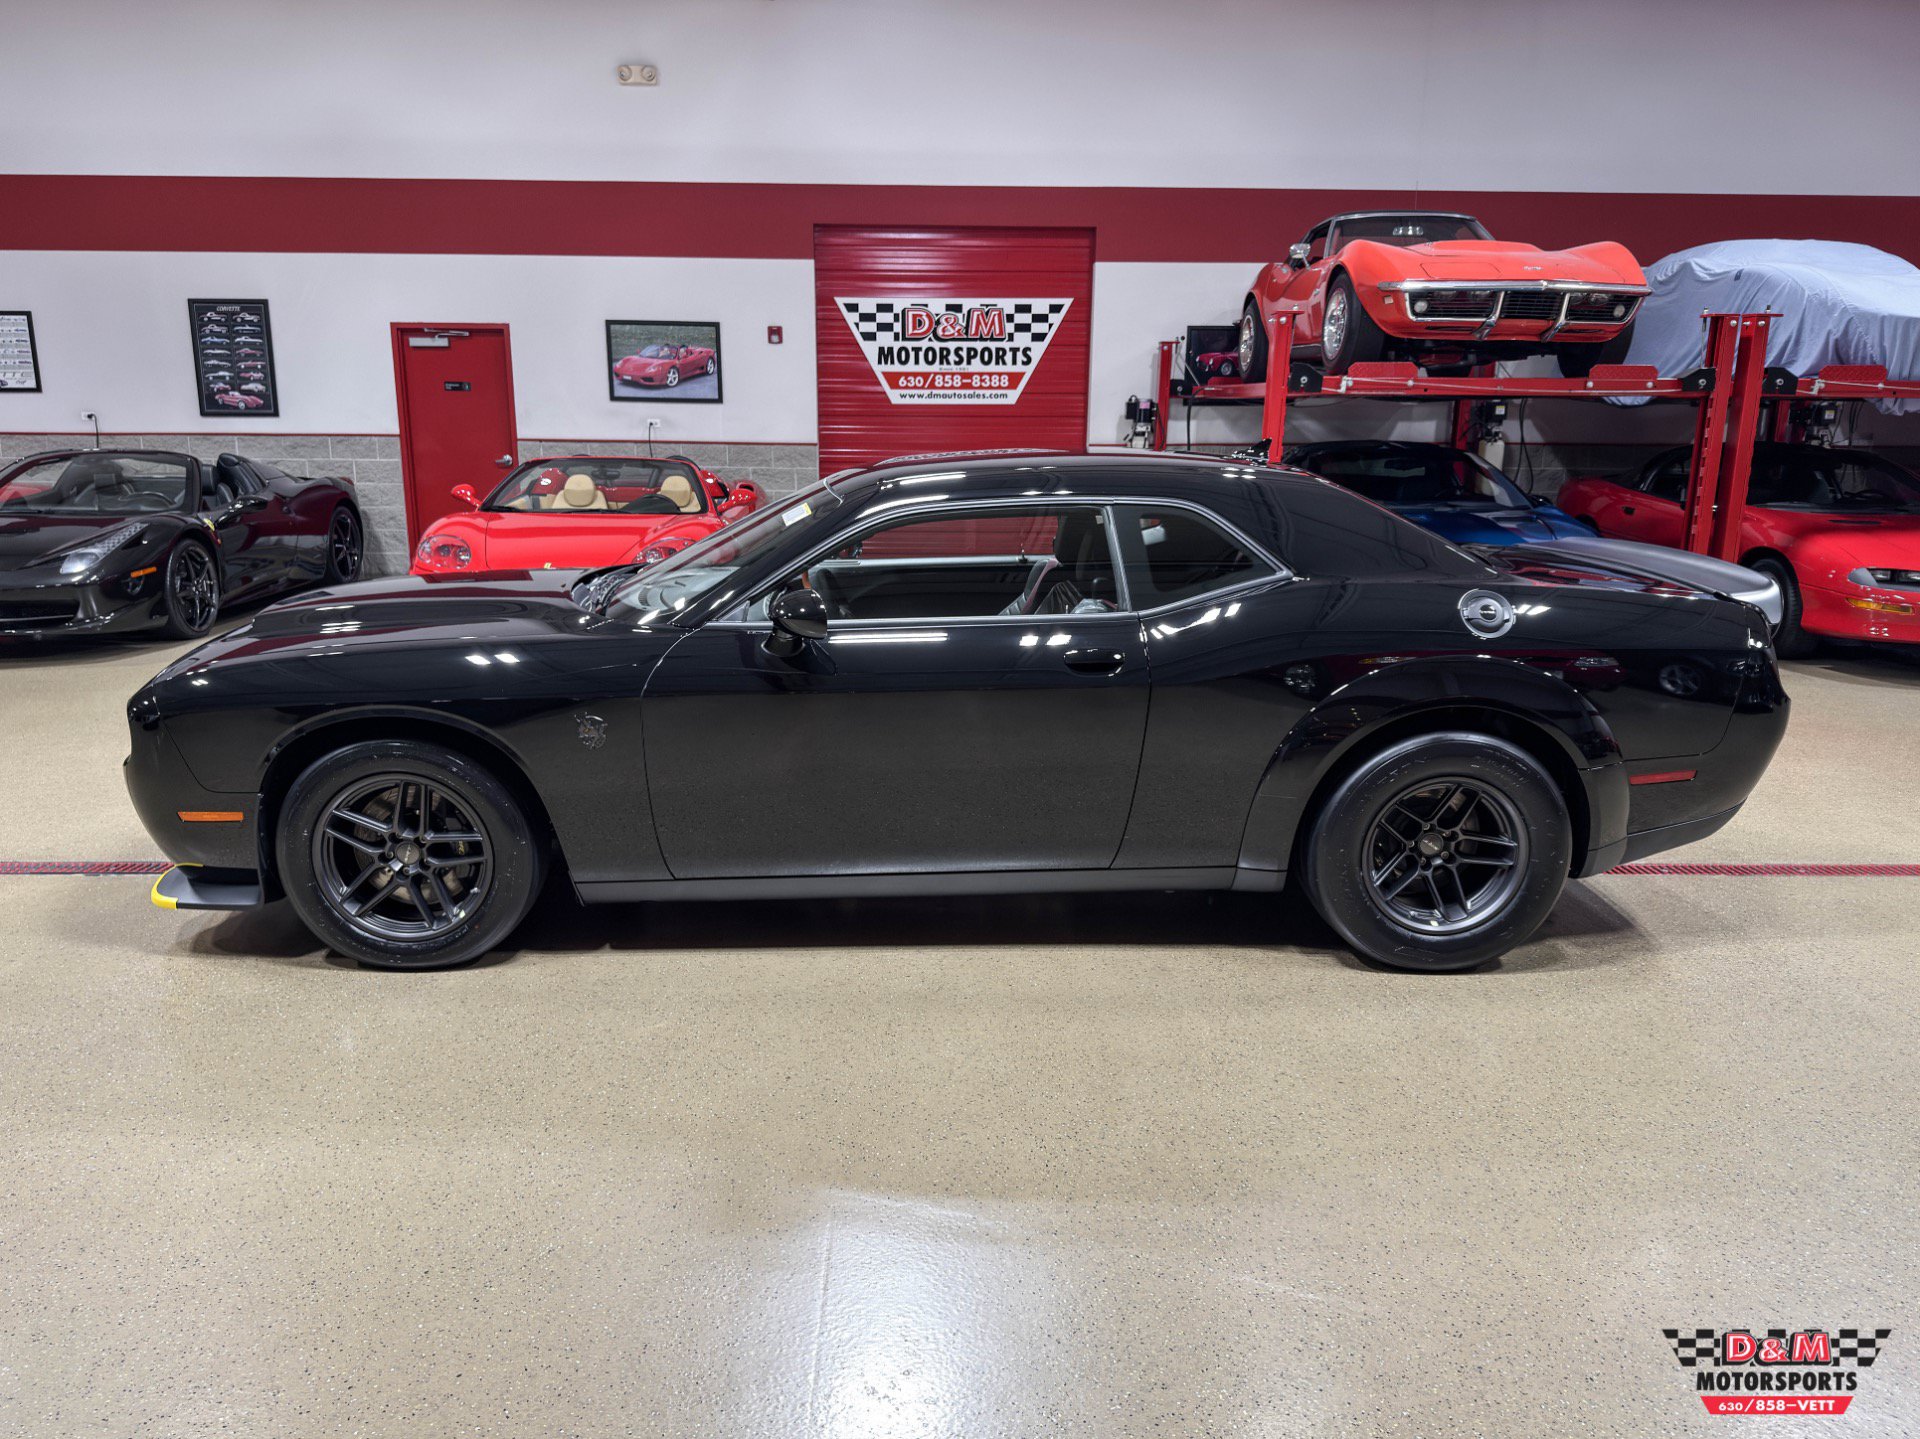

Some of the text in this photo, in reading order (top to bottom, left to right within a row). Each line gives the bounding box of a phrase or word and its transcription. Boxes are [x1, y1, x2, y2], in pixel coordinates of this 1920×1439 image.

[903, 307, 1007, 341] D&M
[877, 346, 1032, 366] MOTORSPORTS
[899, 391, 1008, 400] www.dmautosales.com
